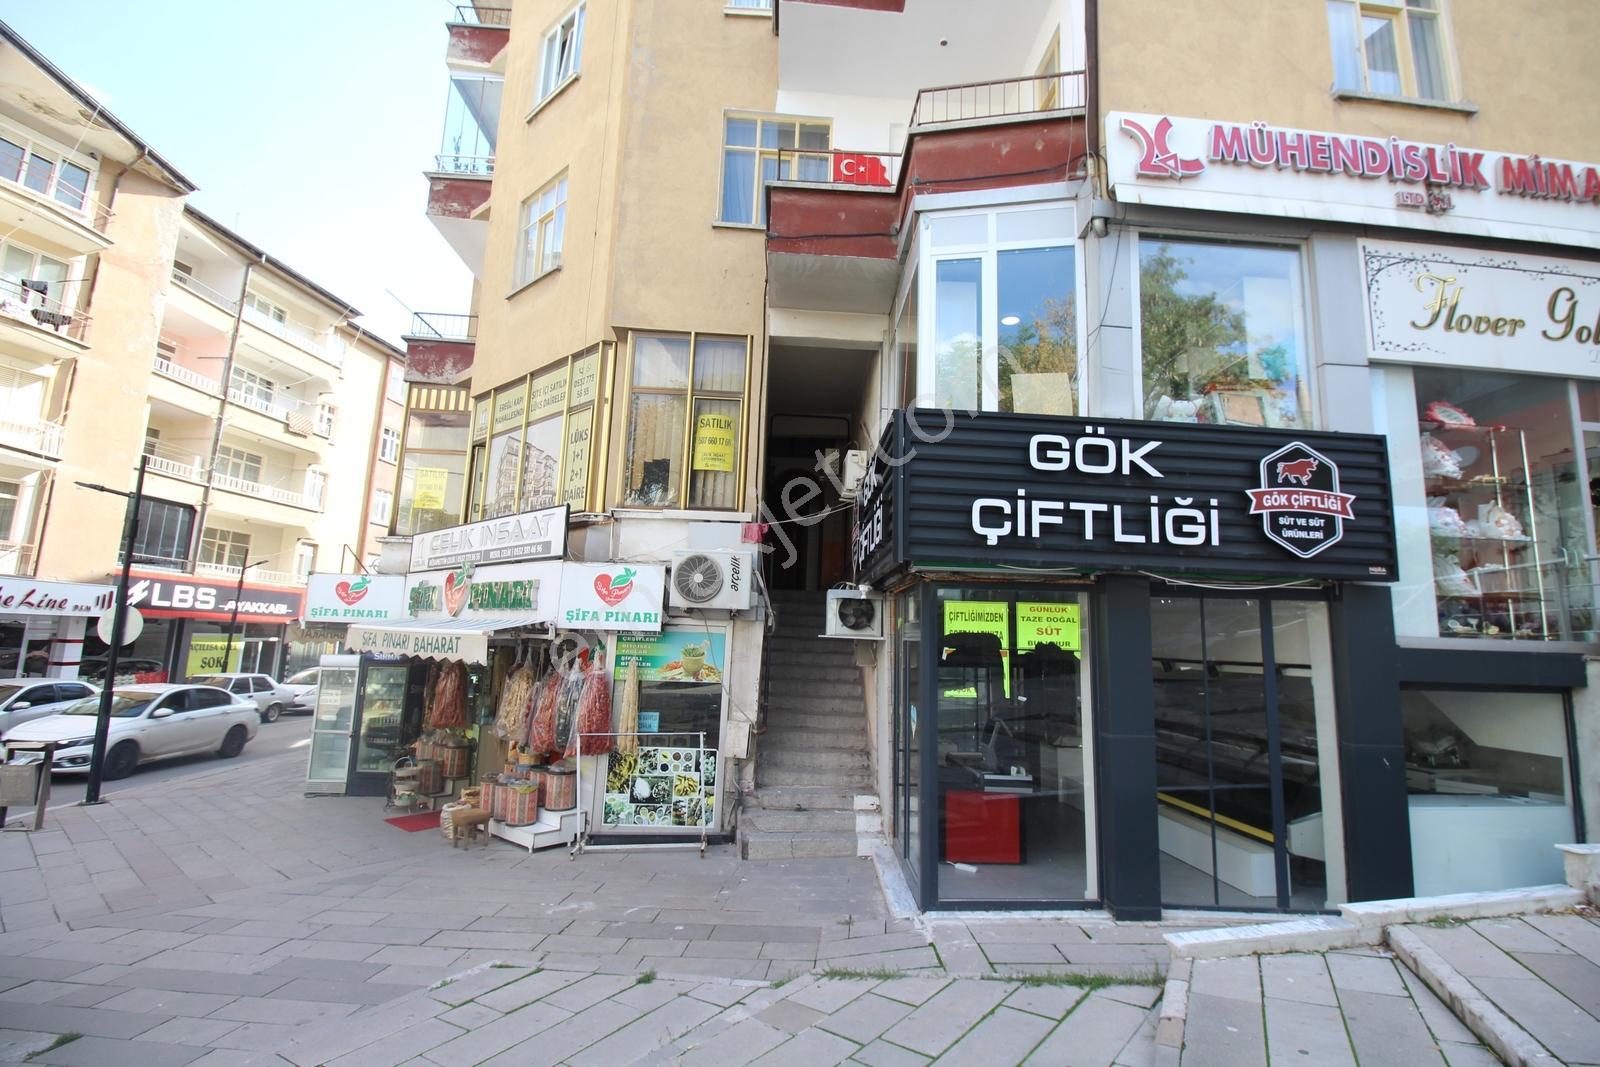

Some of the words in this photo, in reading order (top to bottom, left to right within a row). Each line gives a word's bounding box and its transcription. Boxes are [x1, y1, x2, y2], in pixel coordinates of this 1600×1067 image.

[1208, 120, 1490, 191] MÜHENDİSLİK
[1410, 272, 1526, 338] Flover
[700, 417, 732, 430] SATILIK
[1029, 425, 1164, 478] GÖK
[1263, 491, 1288, 507] GÖK
[1291, 491, 1342, 512] ÇİFTLİĞİ
[971, 488, 1220, 546] ÇİFTLİĞİ
[1279, 515, 1294, 525] SÜT
[1296, 517, 1307, 526] VE
[1308, 517, 1326, 527] SÜT
[1282, 528, 1324, 539] ÜRÜNLERİ
[729, 556, 742, 592] arçelik
[18, 588, 68, 609] Line
[150, 583, 217, 610] LBS
[343, 608, 389, 619] PINARI
[566, 608, 600, 623] ŞİFA
[604, 611, 659, 623] PINARI
[949, 609, 1004, 623] ÇİFTLİĞİMİZDEN
[1029, 605, 1068, 613] GÜNLÜK
[1046, 614, 1077, 624] DOĞAL
[1036, 626, 1062, 636] SÜT
[413, 637, 462, 654] BAHARAT
